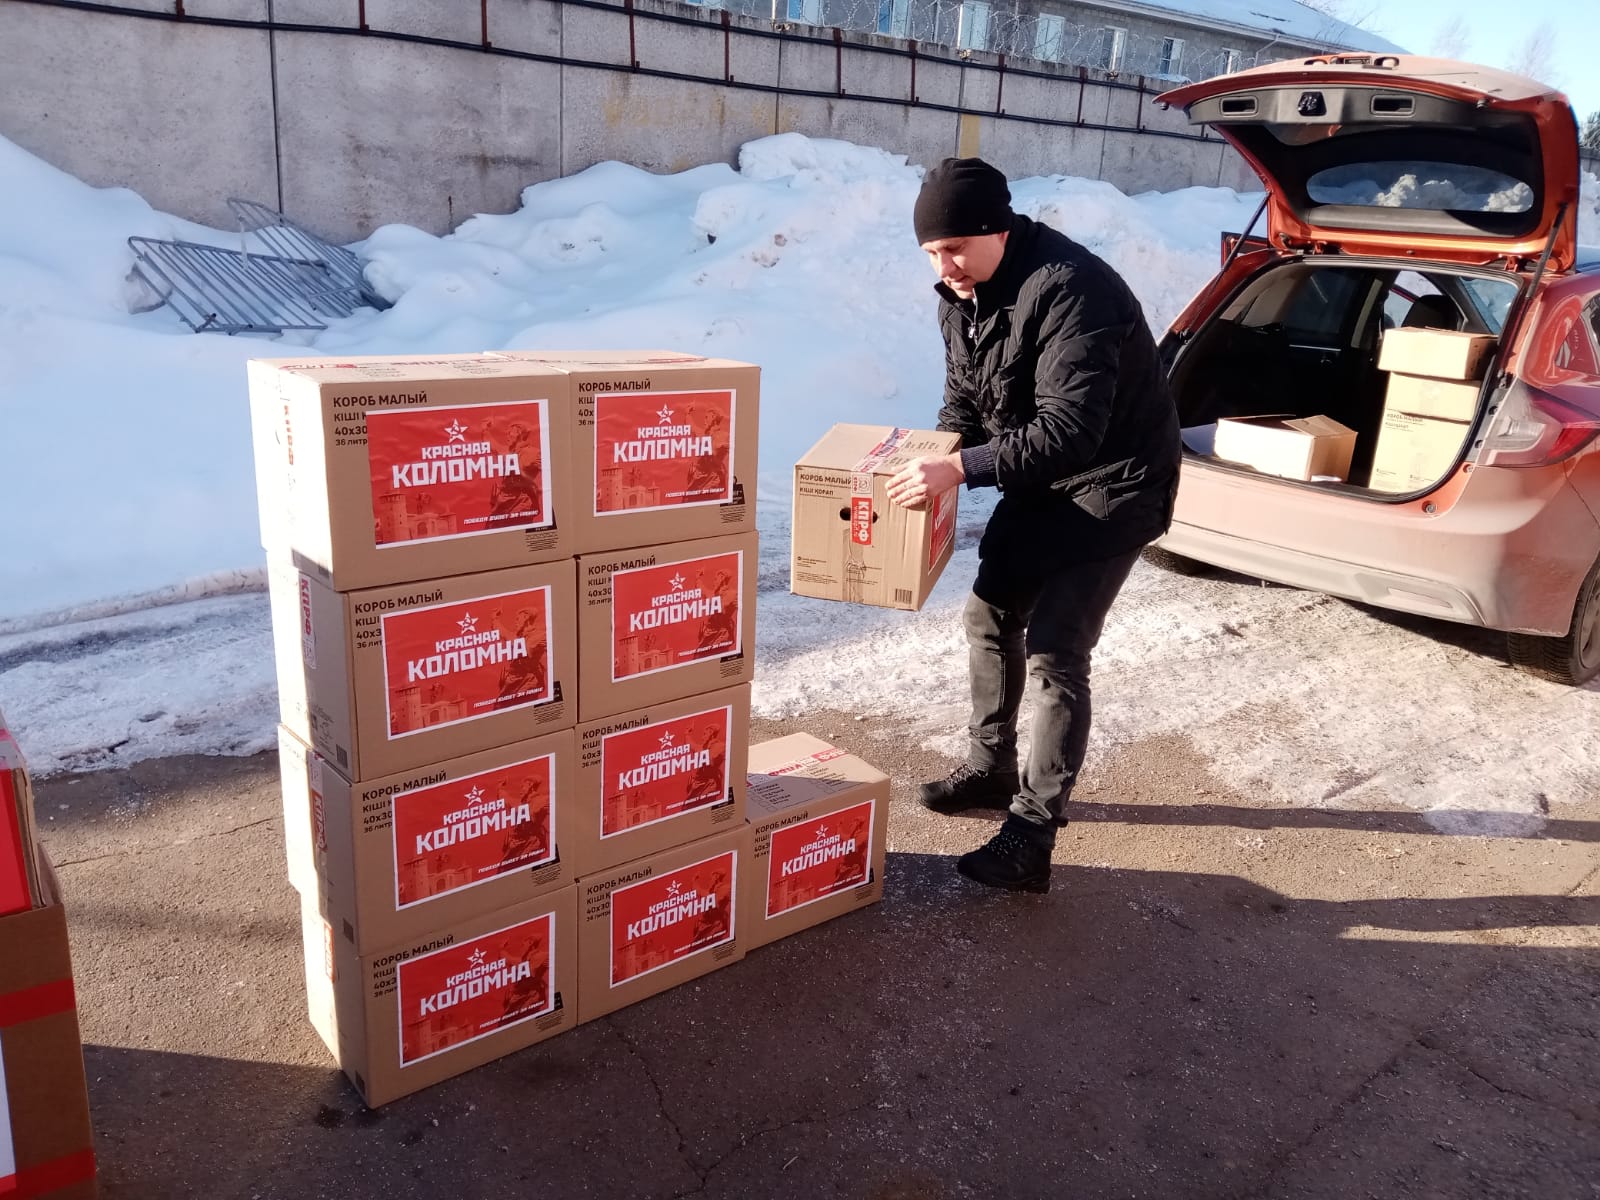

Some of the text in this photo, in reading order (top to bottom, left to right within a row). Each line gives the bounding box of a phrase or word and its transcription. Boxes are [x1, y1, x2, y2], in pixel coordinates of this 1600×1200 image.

[578, 377, 651, 393] КОРОБ МАЛЫЙ
[333, 390, 428, 408] КОРОБ МАЛЫЙ
[335, 438, 346, 447] 36
[637, 424, 692, 439] КРАСНАЯ
[421, 441, 491, 460] КРАСНАЯ
[613, 436, 713, 464] КОЛОМНА
[392, 453, 521, 489] КОЛОМНА
[800, 473, 852, 485] КОРОБ МАЛЫЙ
[858, 500, 870, 542] КПРФ
[588, 554, 656, 576] КОРОБ МАЛЫЙ
[301, 578, 312, 636] КПРФ
[354, 588, 443, 614] КОРОБ МАЛЫЙ
[651, 588, 702, 608] КРАСНАЯ
[629, 595, 723, 633] КОЛОМНА
[356, 641, 367, 649] 36
[435, 629, 500, 653] КРАСНАЯ
[407, 637, 528, 682] КОЛОМНА
[582, 714, 649, 740] КОРОБ МАЛЫЙ
[640, 743, 690, 766] КРАСНАЯ
[618, 749, 710, 790] КОЛОМНА
[362, 770, 447, 802] КОРОБ МАЛЫЙ
[442, 798, 505, 825] КРАСНАЯ
[755, 810, 809, 835] КОРОБ МАЛЫЙ
[415, 803, 531, 855] КОЛОМНА
[781, 838, 856, 877] КОЛОМНА
[800, 834, 840, 855] КРАСНАЯ
[587, 879, 617, 896] КОРОБ
[618, 865, 652, 886] МАЛЫЙ
[648, 889, 697, 916] КРАСНАЯ
[627, 893, 716, 941] КОЛОМНА
[373, 934, 454, 969] КОРОБ МАЛЫЙ
[446, 957, 506, 988] КРАСНАЯ
[420, 960, 531, 1016] КОЛОМНА
